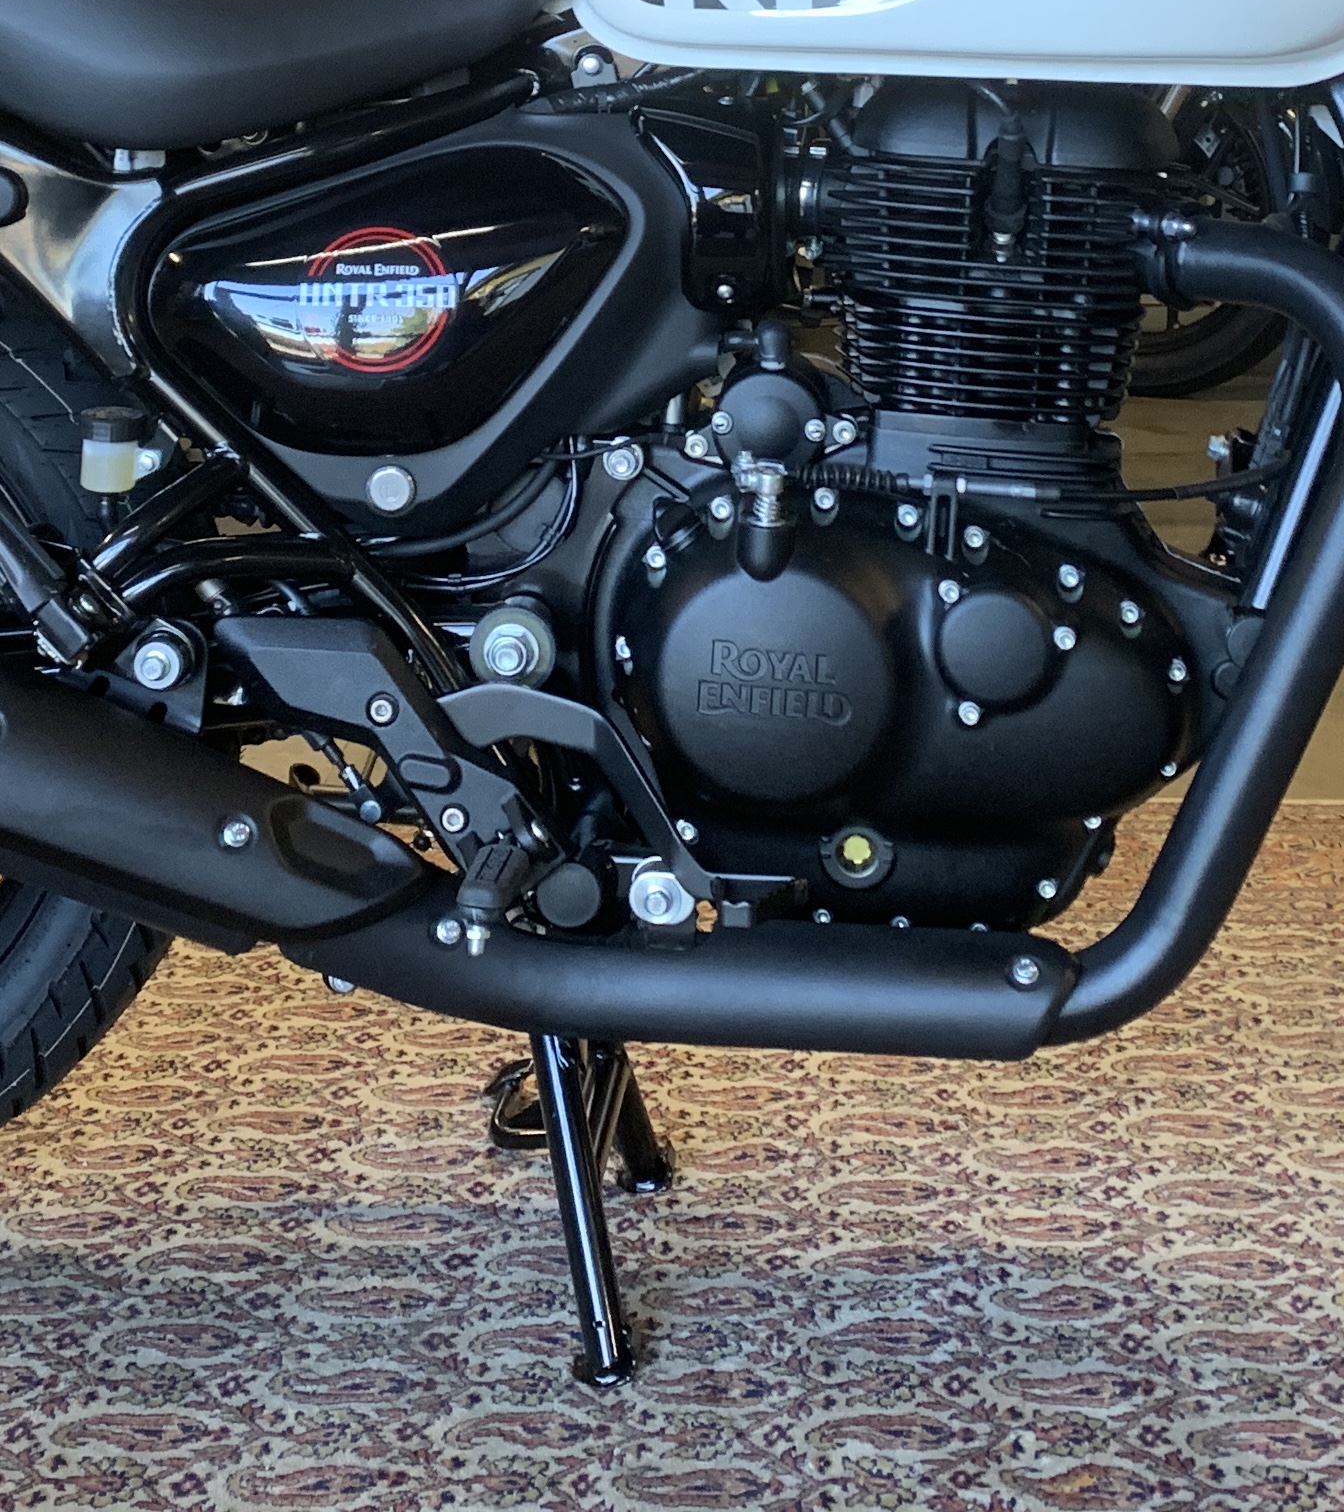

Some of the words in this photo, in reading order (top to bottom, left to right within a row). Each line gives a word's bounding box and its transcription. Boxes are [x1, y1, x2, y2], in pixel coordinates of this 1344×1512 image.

[336, 264, 372, 276] ROYAL
[374, 263, 420, 276] ENFIELD
[299, 282, 389, 307] HNTR
[395, 284, 457, 308] 350
[348, 314, 377, 324] SINCE
[711, 638, 836, 685] ROYAL
[696, 679, 853, 727] ENFIELD
